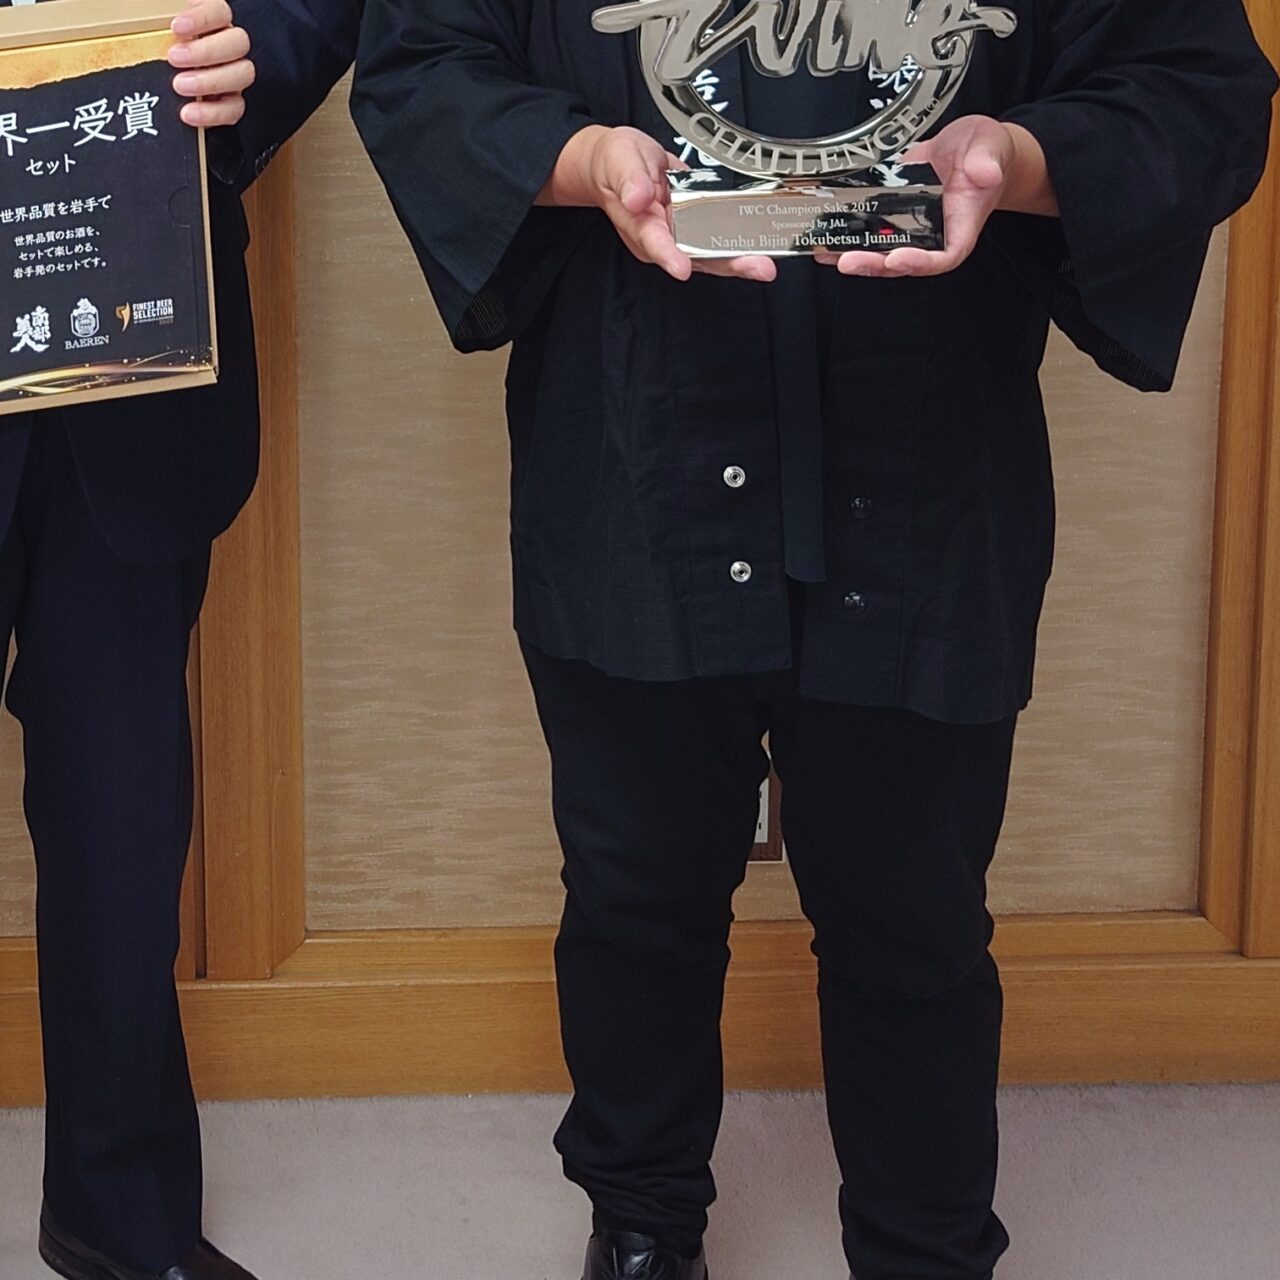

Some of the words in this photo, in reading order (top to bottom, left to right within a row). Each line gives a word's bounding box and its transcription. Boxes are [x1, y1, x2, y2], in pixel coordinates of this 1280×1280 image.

[688, 104, 926, 175] CHALLENGE
[25, 153, 76, 176] セット
[739, 204, 764, 216] IWC
[766, 202, 820, 217] Champion
[823, 201, 848, 213] Sake
[851, 201, 879, 213] 2017
[817, 219, 828, 230] by
[829, 219, 848, 228] JAL
[711, 234, 756, 249] Nanbu
[759, 233, 789, 249] Bijin
[792, 231, 860, 246] Tokubetsu
[863, 231, 911, 245] Junmai
[132, 301, 155, 311] FINEST
[156, 298, 173, 308] BEER
[132, 306, 174, 320] SELECTION
[64, 335, 110, 350] BAEREN
